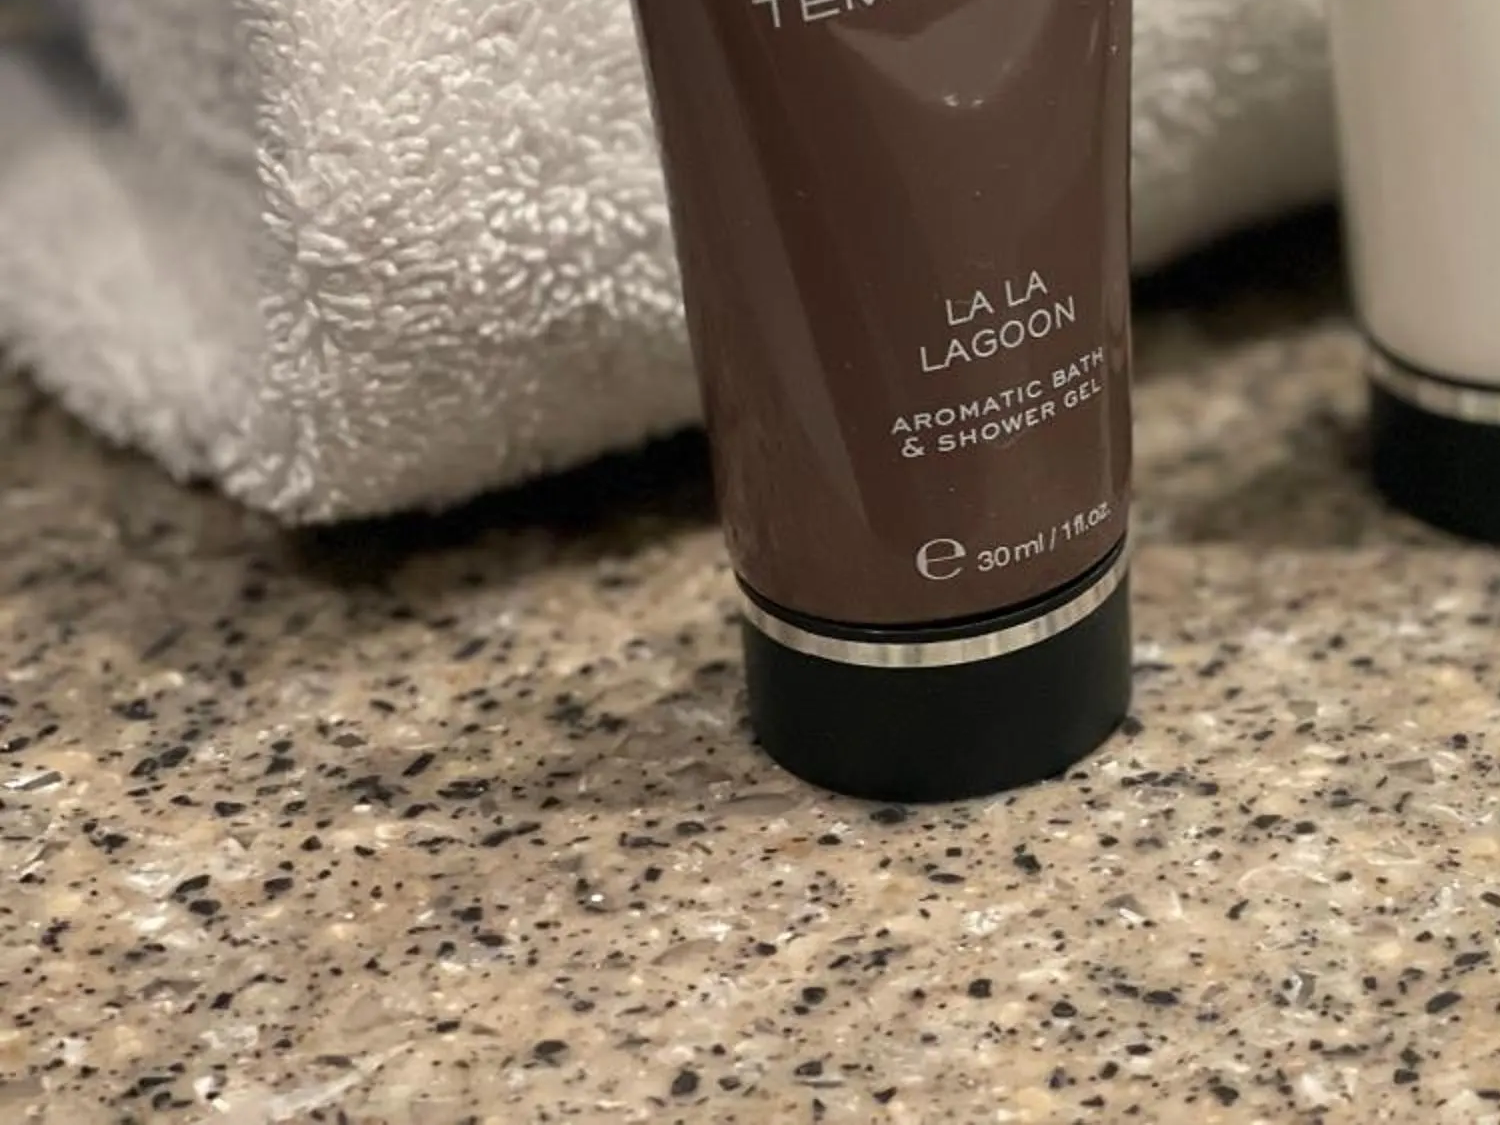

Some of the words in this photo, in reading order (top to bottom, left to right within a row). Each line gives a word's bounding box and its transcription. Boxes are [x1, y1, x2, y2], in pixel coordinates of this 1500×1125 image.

[920, 296, 1076, 372] LAGOON
[946, 290, 993, 325] LA
[1005, 270, 1048, 307] LA
[891, 380, 1044, 435] AROMATIC
[1051, 346, 1105, 388] BATH
[901, 436, 926, 458] &
[937, 401, 1056, 453] SHOWER
[1064, 378, 1102, 408] GEL
